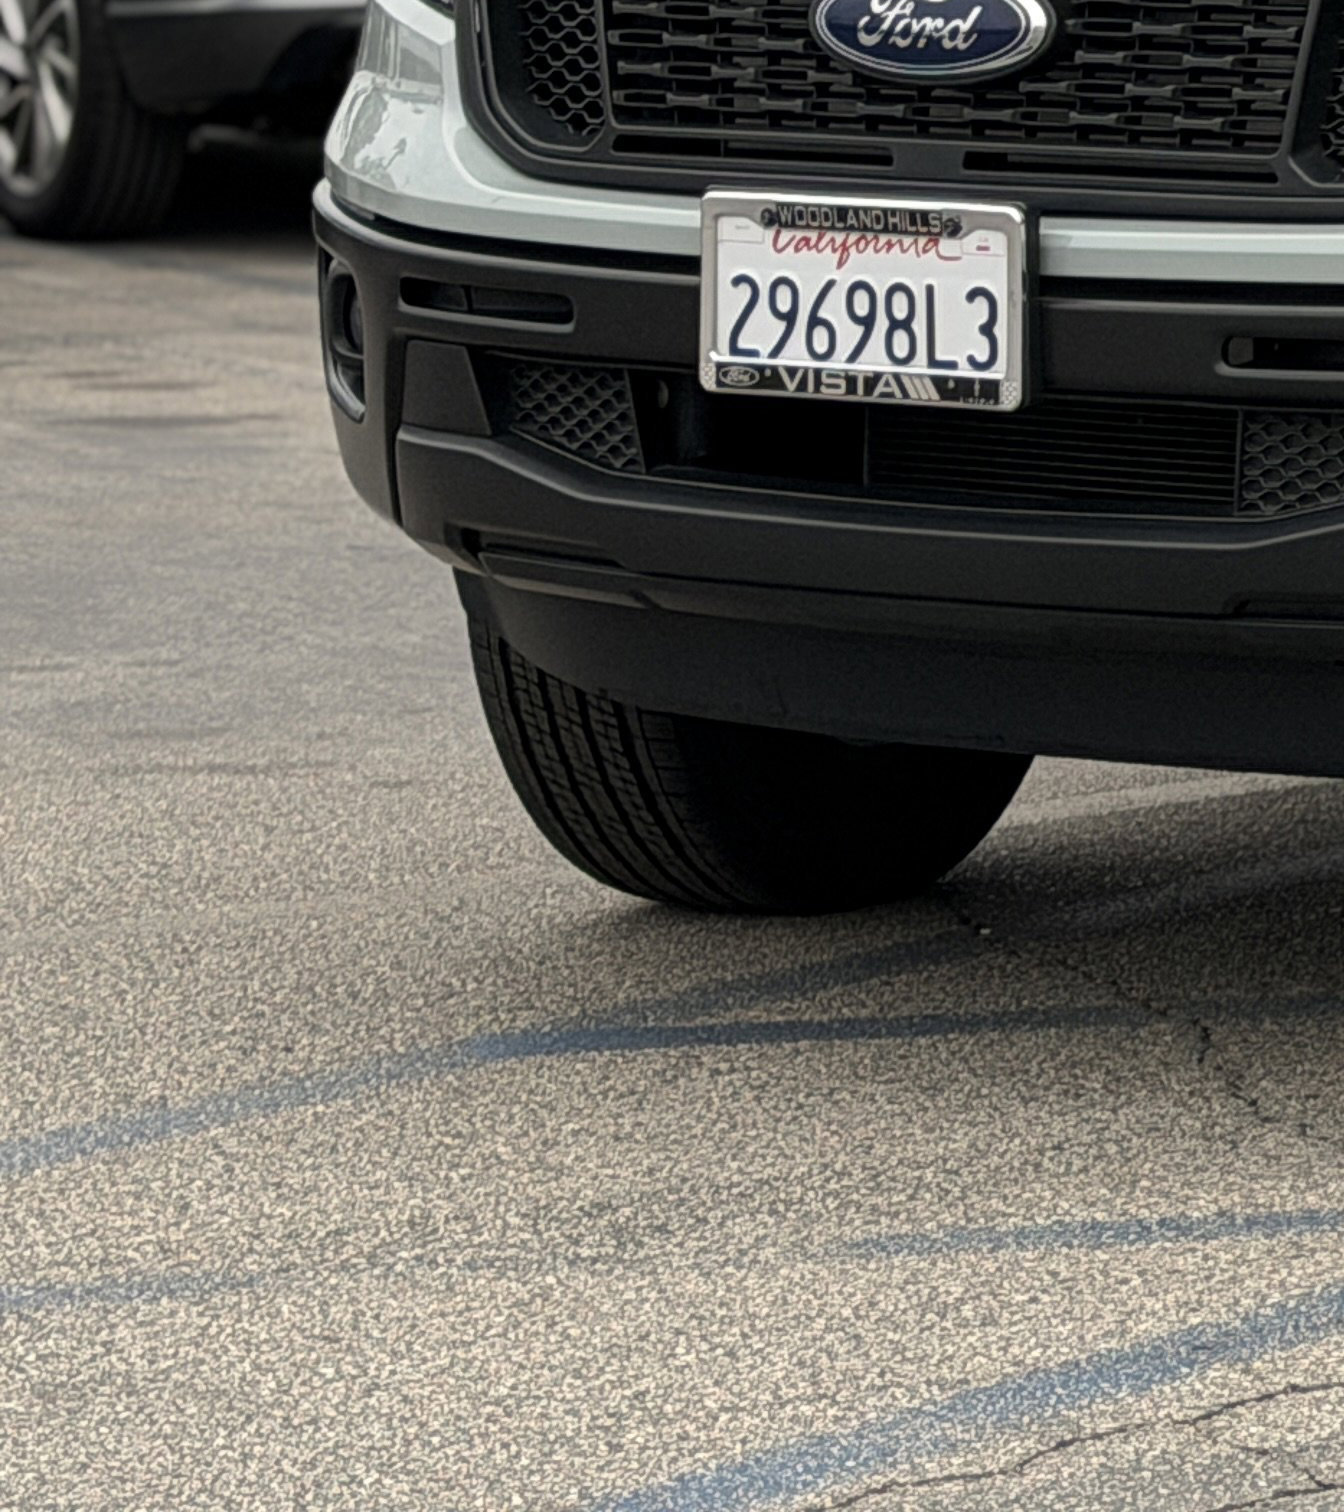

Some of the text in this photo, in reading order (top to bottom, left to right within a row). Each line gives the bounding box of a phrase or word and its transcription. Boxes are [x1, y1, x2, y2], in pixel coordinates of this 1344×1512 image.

[776, 205, 942, 234] WOODLAND HILLS
[771, 228, 963, 270] California
[728, 273, 999, 372] 29698L3
[777, 367, 904, 400] VISTA
